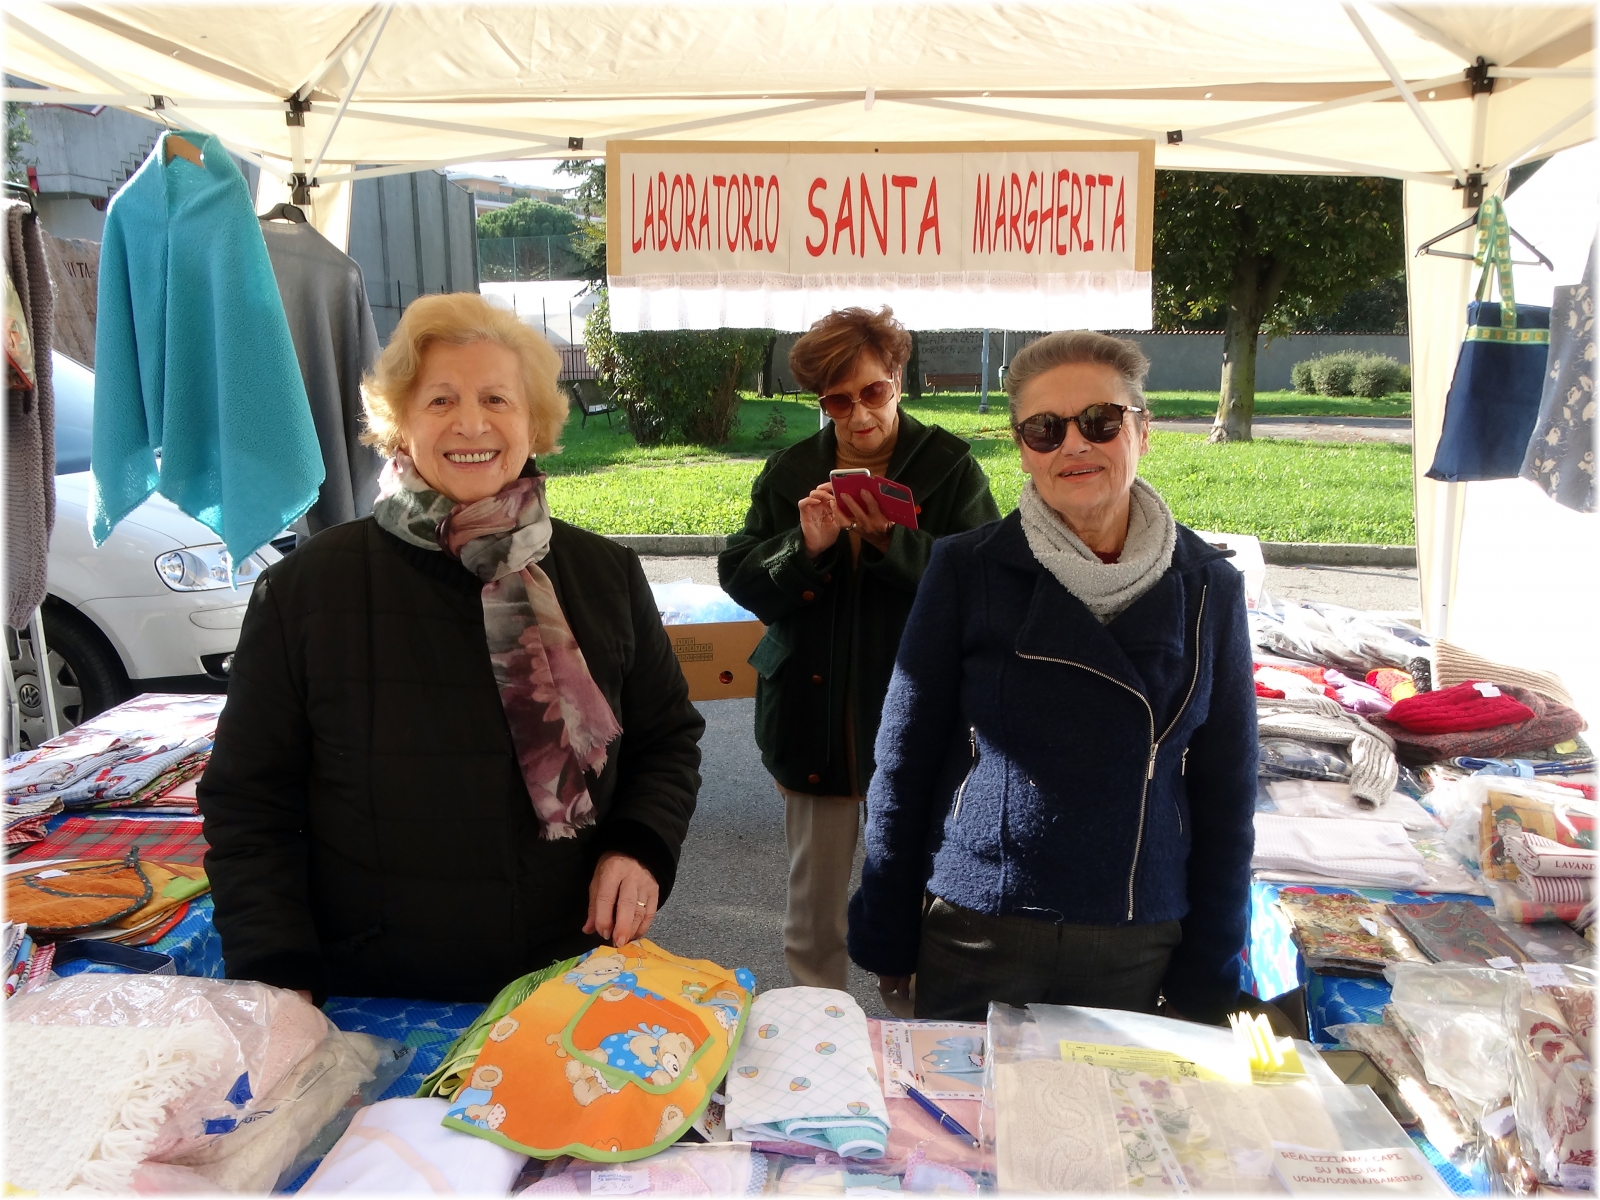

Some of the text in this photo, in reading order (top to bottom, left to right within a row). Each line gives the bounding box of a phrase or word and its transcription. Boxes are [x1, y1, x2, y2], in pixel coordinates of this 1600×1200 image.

[632, 169, 1125, 257] LABORATORIO SANTA MARGHERITA
[1281, 1151, 1403, 1163] REALIZZIAMO CAPI
[1314, 1166, 1332, 1174] SU
[1292, 1174, 1424, 1185] UOMO/DONNA/BAMBINO
